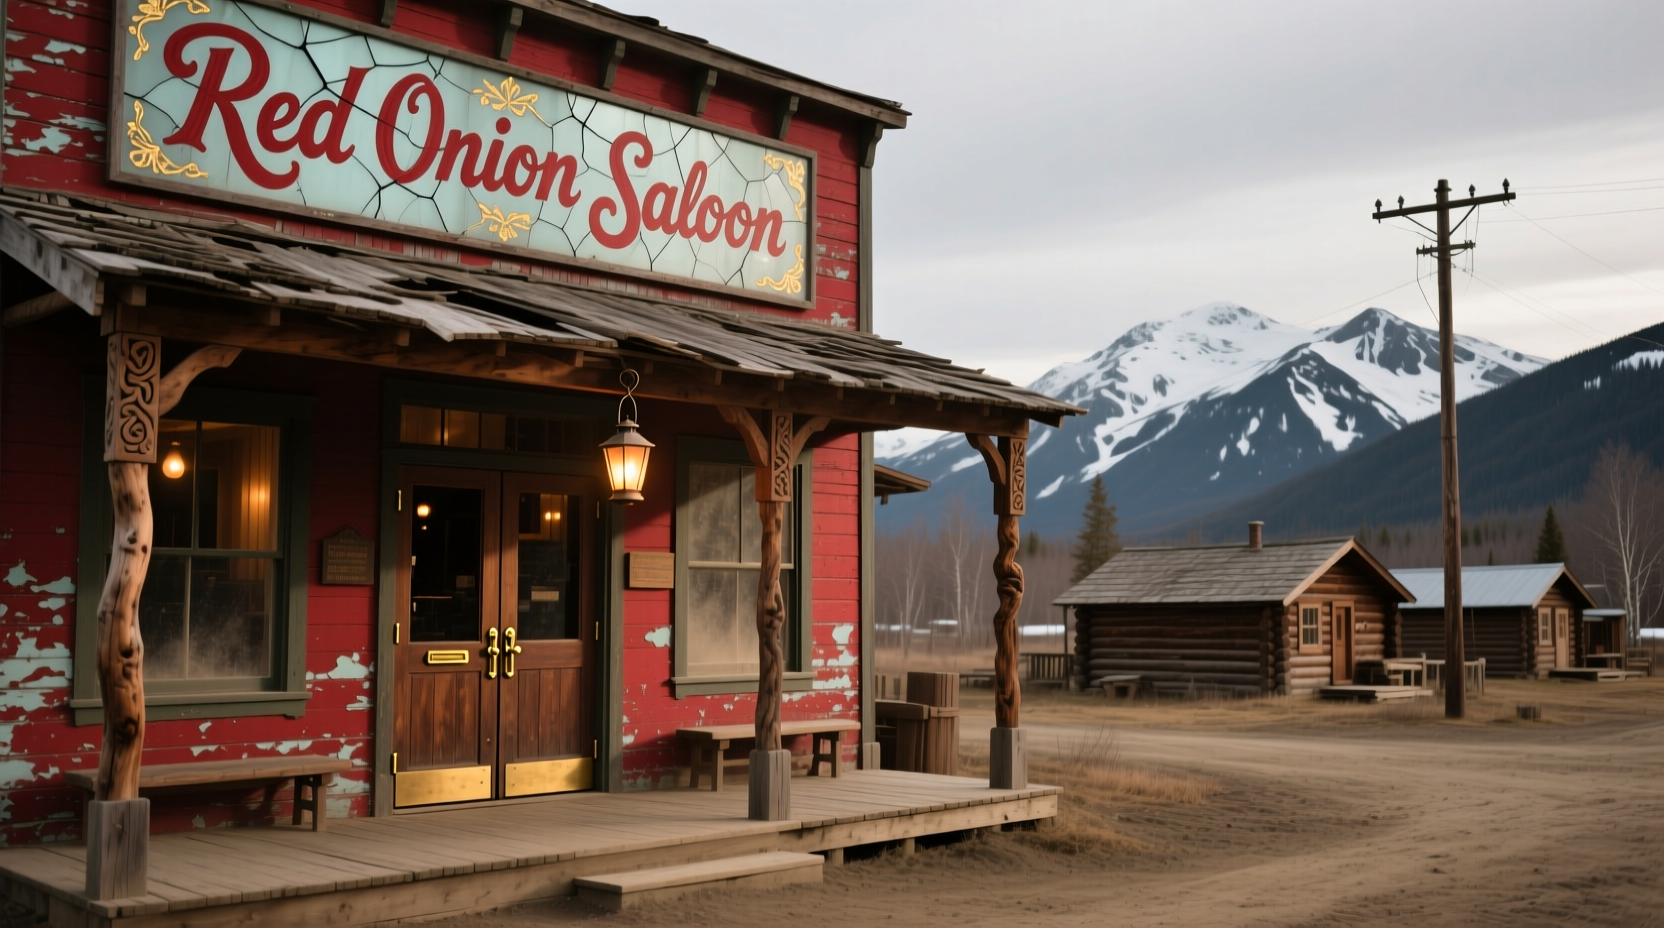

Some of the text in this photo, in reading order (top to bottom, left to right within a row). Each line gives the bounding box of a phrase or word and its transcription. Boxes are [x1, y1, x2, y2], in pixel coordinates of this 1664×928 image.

[163, 22, 787, 257] Red Onion Saloon
